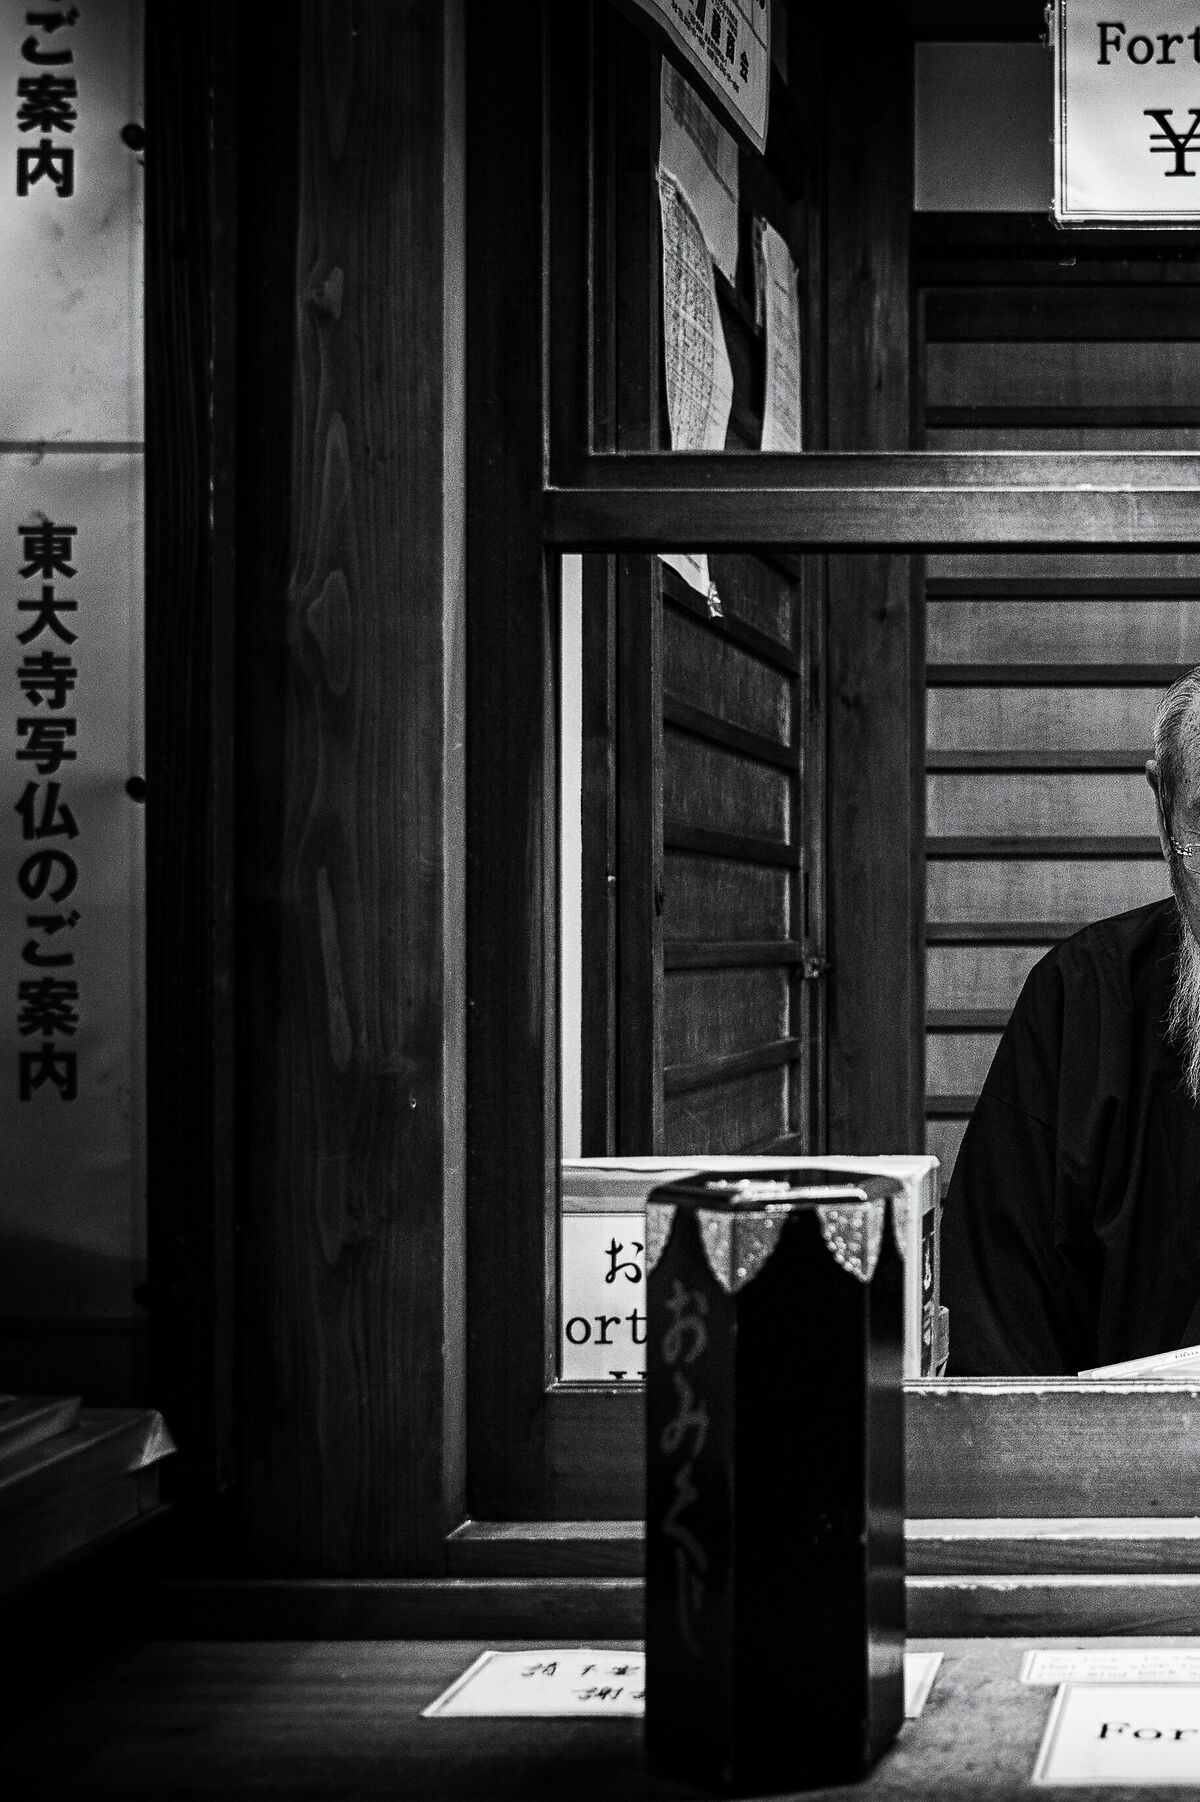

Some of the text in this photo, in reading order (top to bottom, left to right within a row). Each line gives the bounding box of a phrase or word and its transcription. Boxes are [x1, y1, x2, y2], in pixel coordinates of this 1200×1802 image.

[15, 521, 80, 1101] 東大寺写仏のご案内
[604, 1236, 645, 1284] お
[660, 1278, 711, 1661] おみくじ
